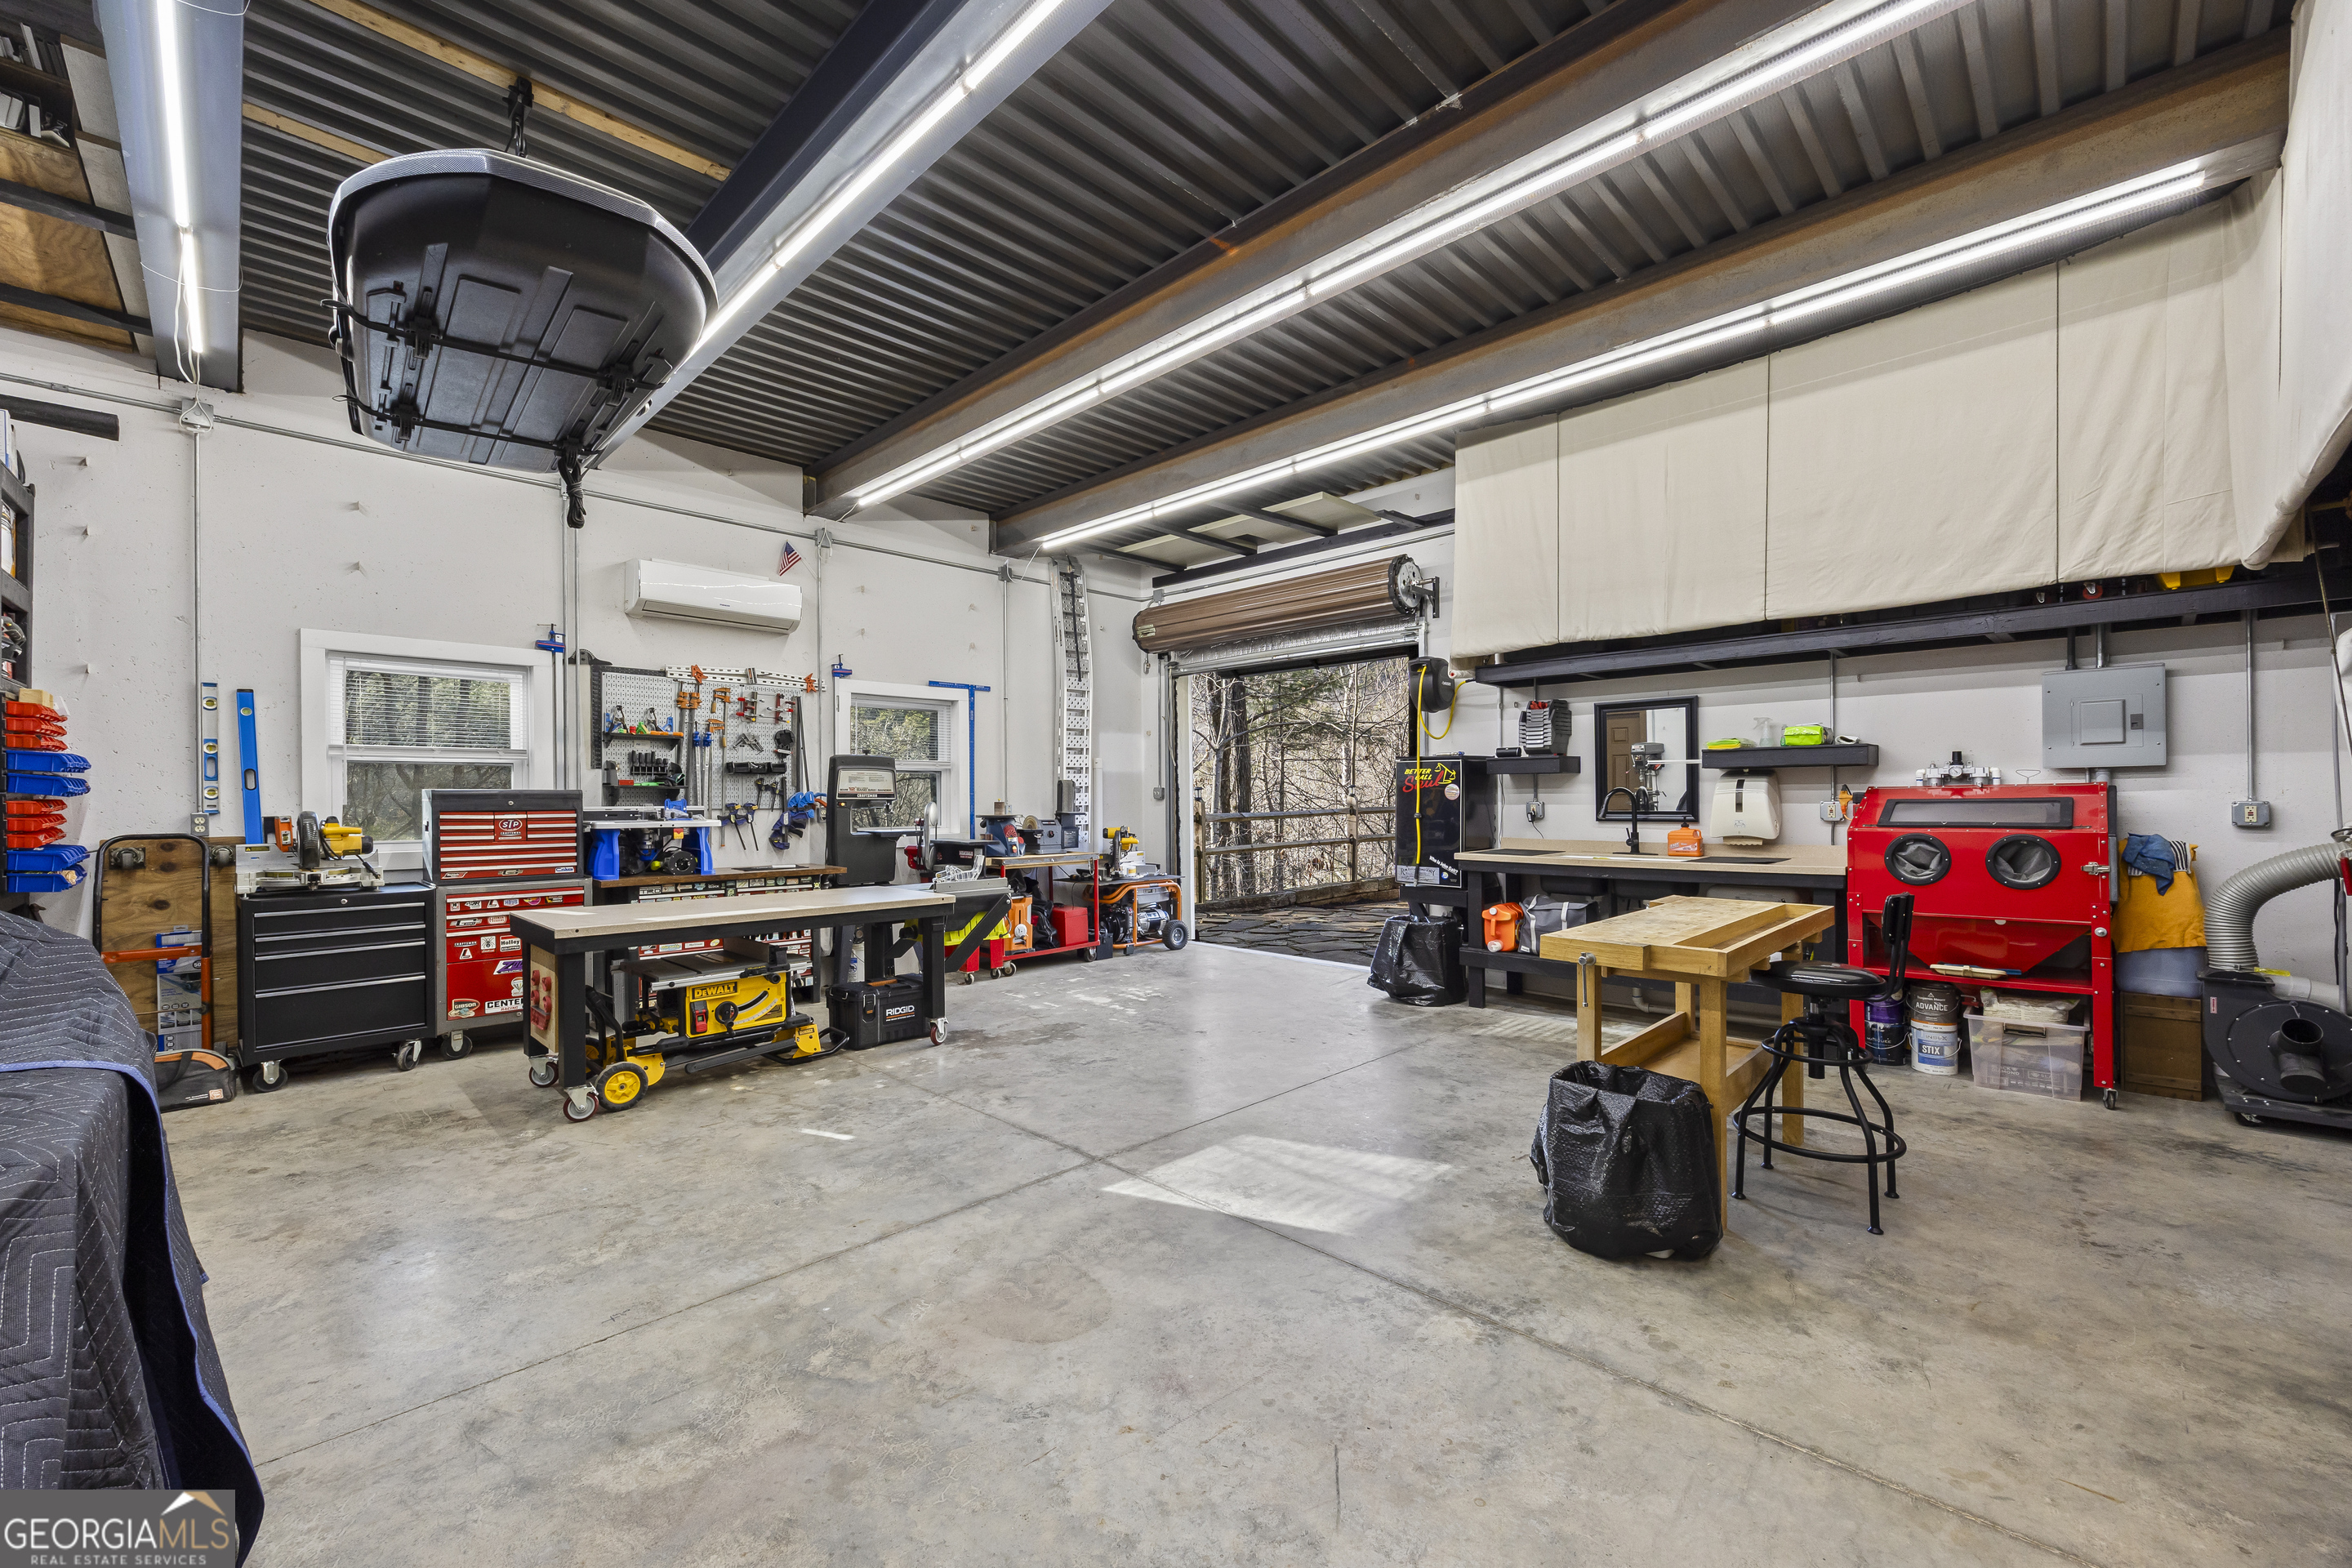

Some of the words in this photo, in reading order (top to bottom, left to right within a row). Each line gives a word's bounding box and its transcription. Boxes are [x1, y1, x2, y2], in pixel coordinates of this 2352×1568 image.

[1402, 770, 1444, 792] Saul
[502, 819, 519, 829] STP
[694, 982, 736, 997] DEWALT
[885, 1004, 915, 1017] RIDGID
[1915, 1001, 1949, 1012] ADVANCE
[1922, 1045, 1940, 1055] STIX
